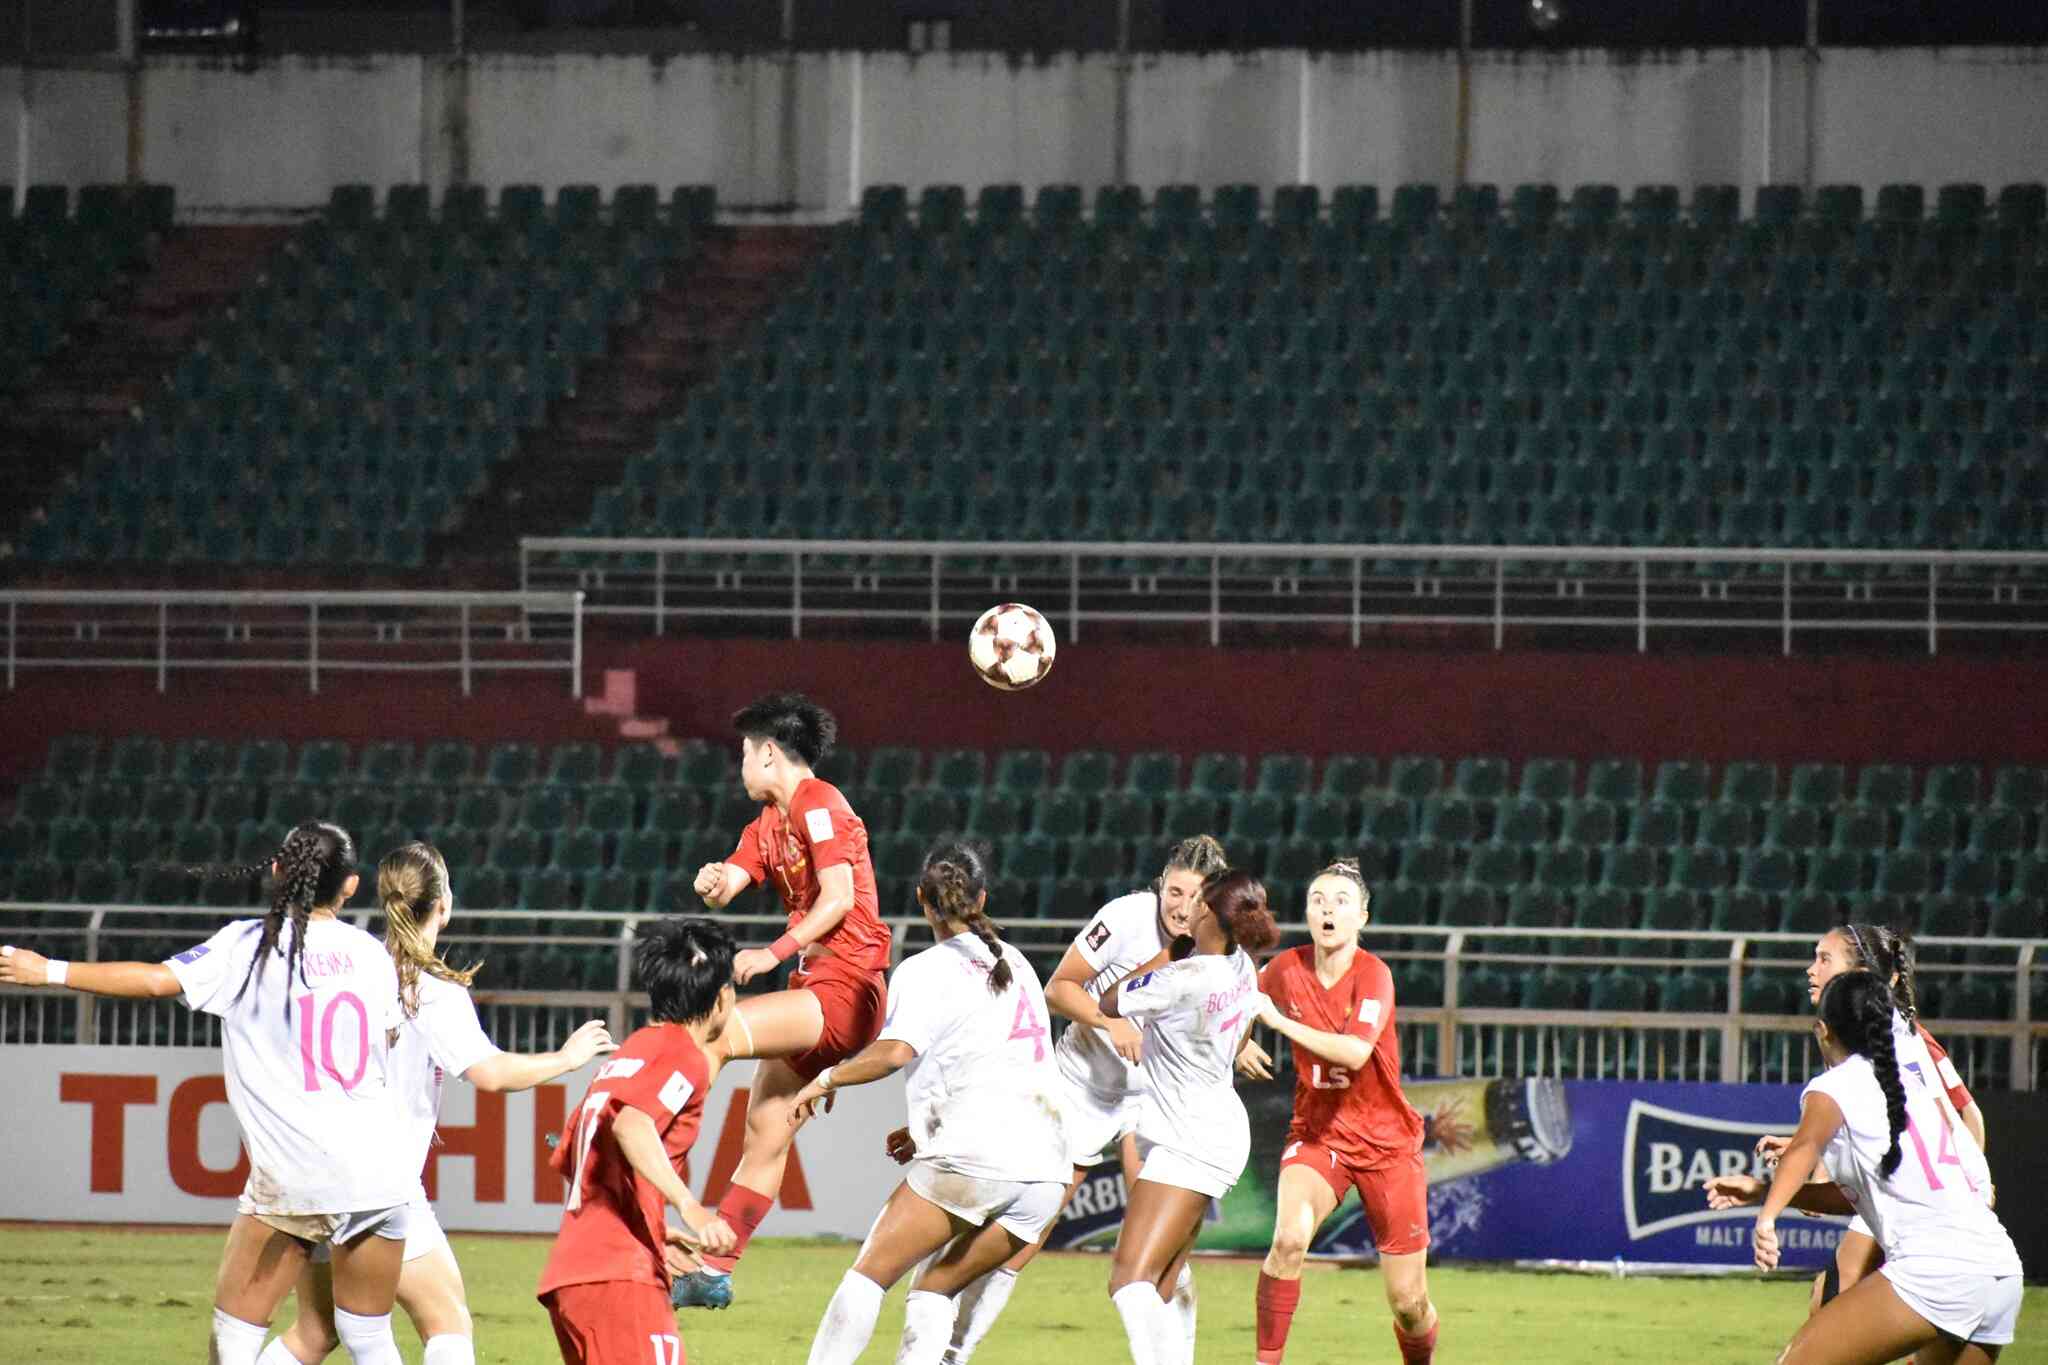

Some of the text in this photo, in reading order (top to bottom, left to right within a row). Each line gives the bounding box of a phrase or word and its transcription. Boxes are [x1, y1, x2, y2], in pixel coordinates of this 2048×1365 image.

[296, 991, 369, 1092] 10
[1008, 984, 1046, 1063] 4
[1220, 1009, 1243, 1068] 7
[1312, 1064, 1350, 1089] LS
[59, 1072, 814, 1211] TOHIA
[1695, 1226, 1746, 1248] MALT
